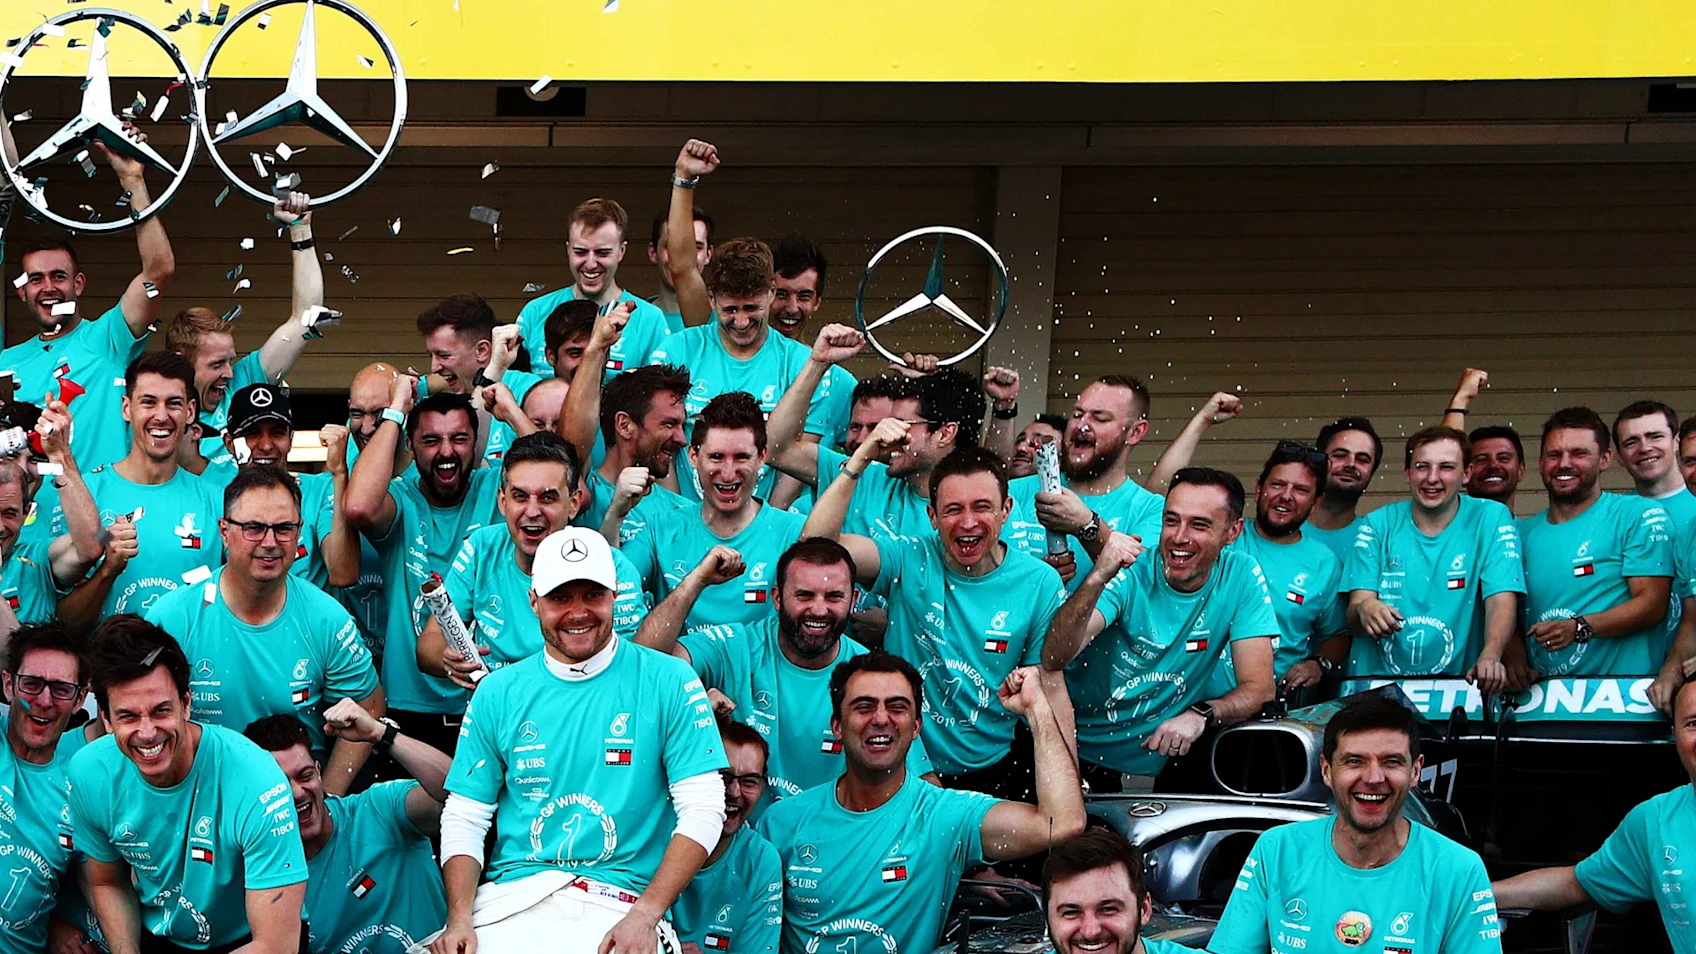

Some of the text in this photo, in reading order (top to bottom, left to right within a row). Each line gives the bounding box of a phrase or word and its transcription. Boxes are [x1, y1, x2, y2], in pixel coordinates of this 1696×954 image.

[1028, 531, 1046, 541] UBS
[124, 577, 179, 597] GP WINNER
[616, 602, 636, 613] IWC
[1407, 616, 1446, 631] WINNERS
[483, 625, 500, 639] UBS
[445, 615, 477, 664] LBERREGEN
[944, 658, 985, 687] WINNERS
[1125, 676, 1141, 690] GP
[200, 692, 221, 702] UBS
[930, 711, 956, 728] 2019
[525, 756, 546, 769] UBS
[514, 776, 551, 785] Qualcomm
[258, 781, 287, 805] EPSON
[273, 810, 291, 823] IWC
[539, 801, 555, 818] GP
[270, 821, 295, 838] TIBCO
[0, 844, 54, 881] GP WINNERS
[798, 878, 818, 890] UBS
[1472, 889, 1493, 902] EPS
[1482, 914, 1498, 926] IW
[830, 918, 885, 938] WINNERS
[341, 923, 385, 954] WINNERS
[1285, 935, 1308, 949] UBS
[1383, 936, 1416, 945] PETRONAS
